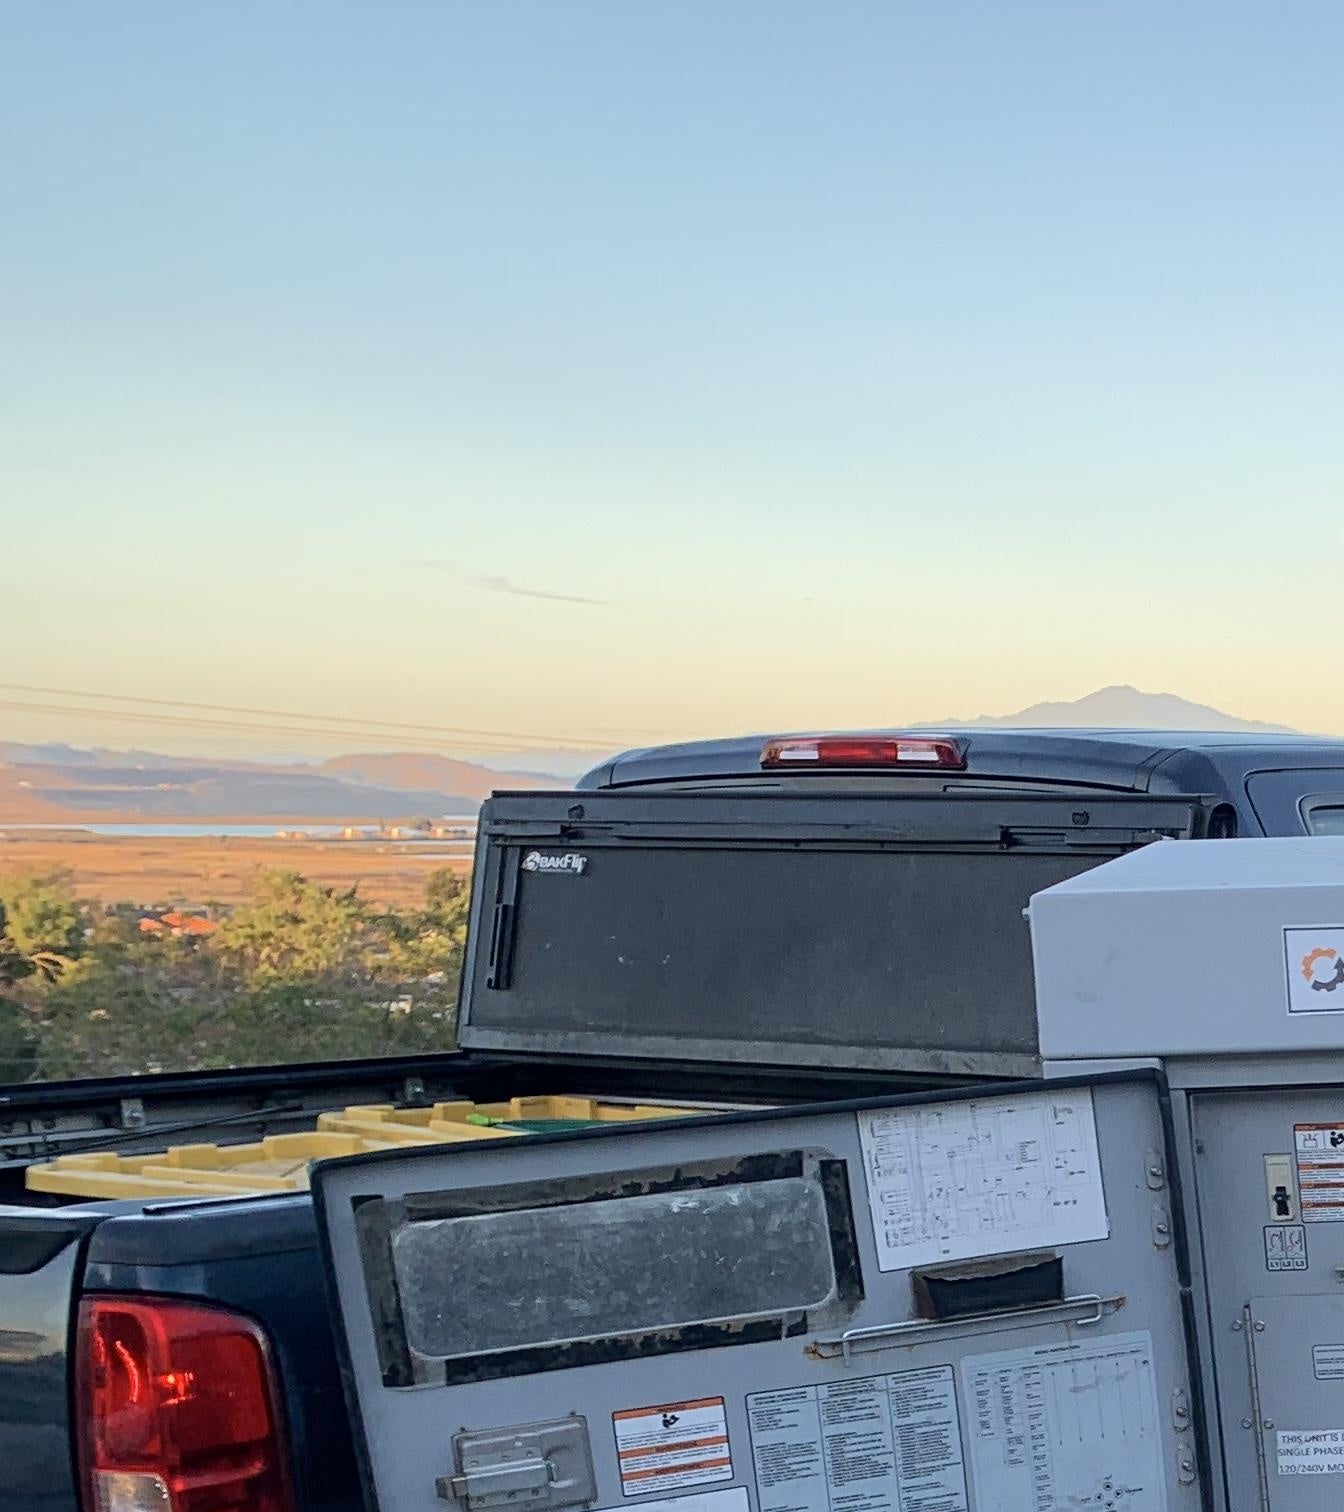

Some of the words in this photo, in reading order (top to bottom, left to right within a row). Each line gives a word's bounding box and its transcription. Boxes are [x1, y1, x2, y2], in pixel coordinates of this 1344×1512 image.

[1281, 1434, 1302, 1444] THIS
[1331, 1432, 1339, 1442] IS
[1278, 1447, 1311, 1457] SINGLE
[1313, 1446, 1344, 1456] PHASE
